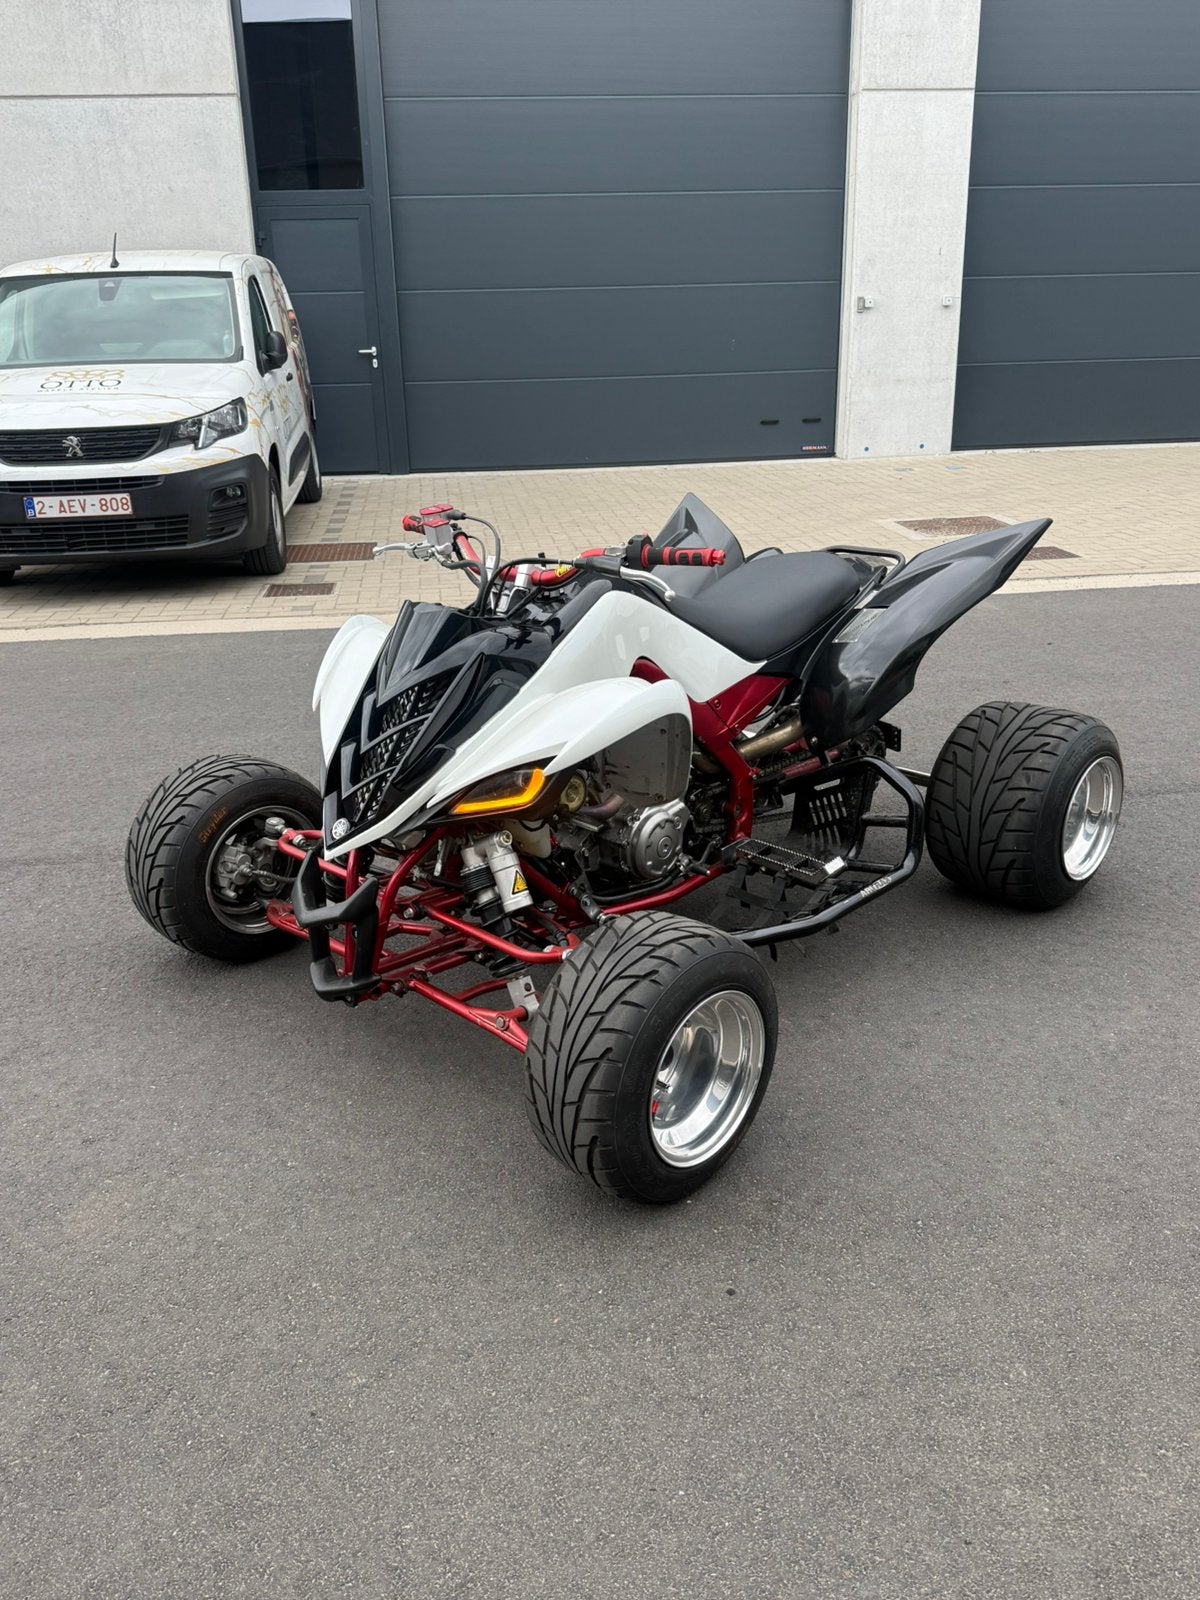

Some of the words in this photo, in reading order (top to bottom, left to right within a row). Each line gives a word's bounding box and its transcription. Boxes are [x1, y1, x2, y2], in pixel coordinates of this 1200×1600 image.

[40, 379, 121, 389] OTTO
[36, 497, 130, 515] 2-AEV-808
[27, 509, 35, 517] B
